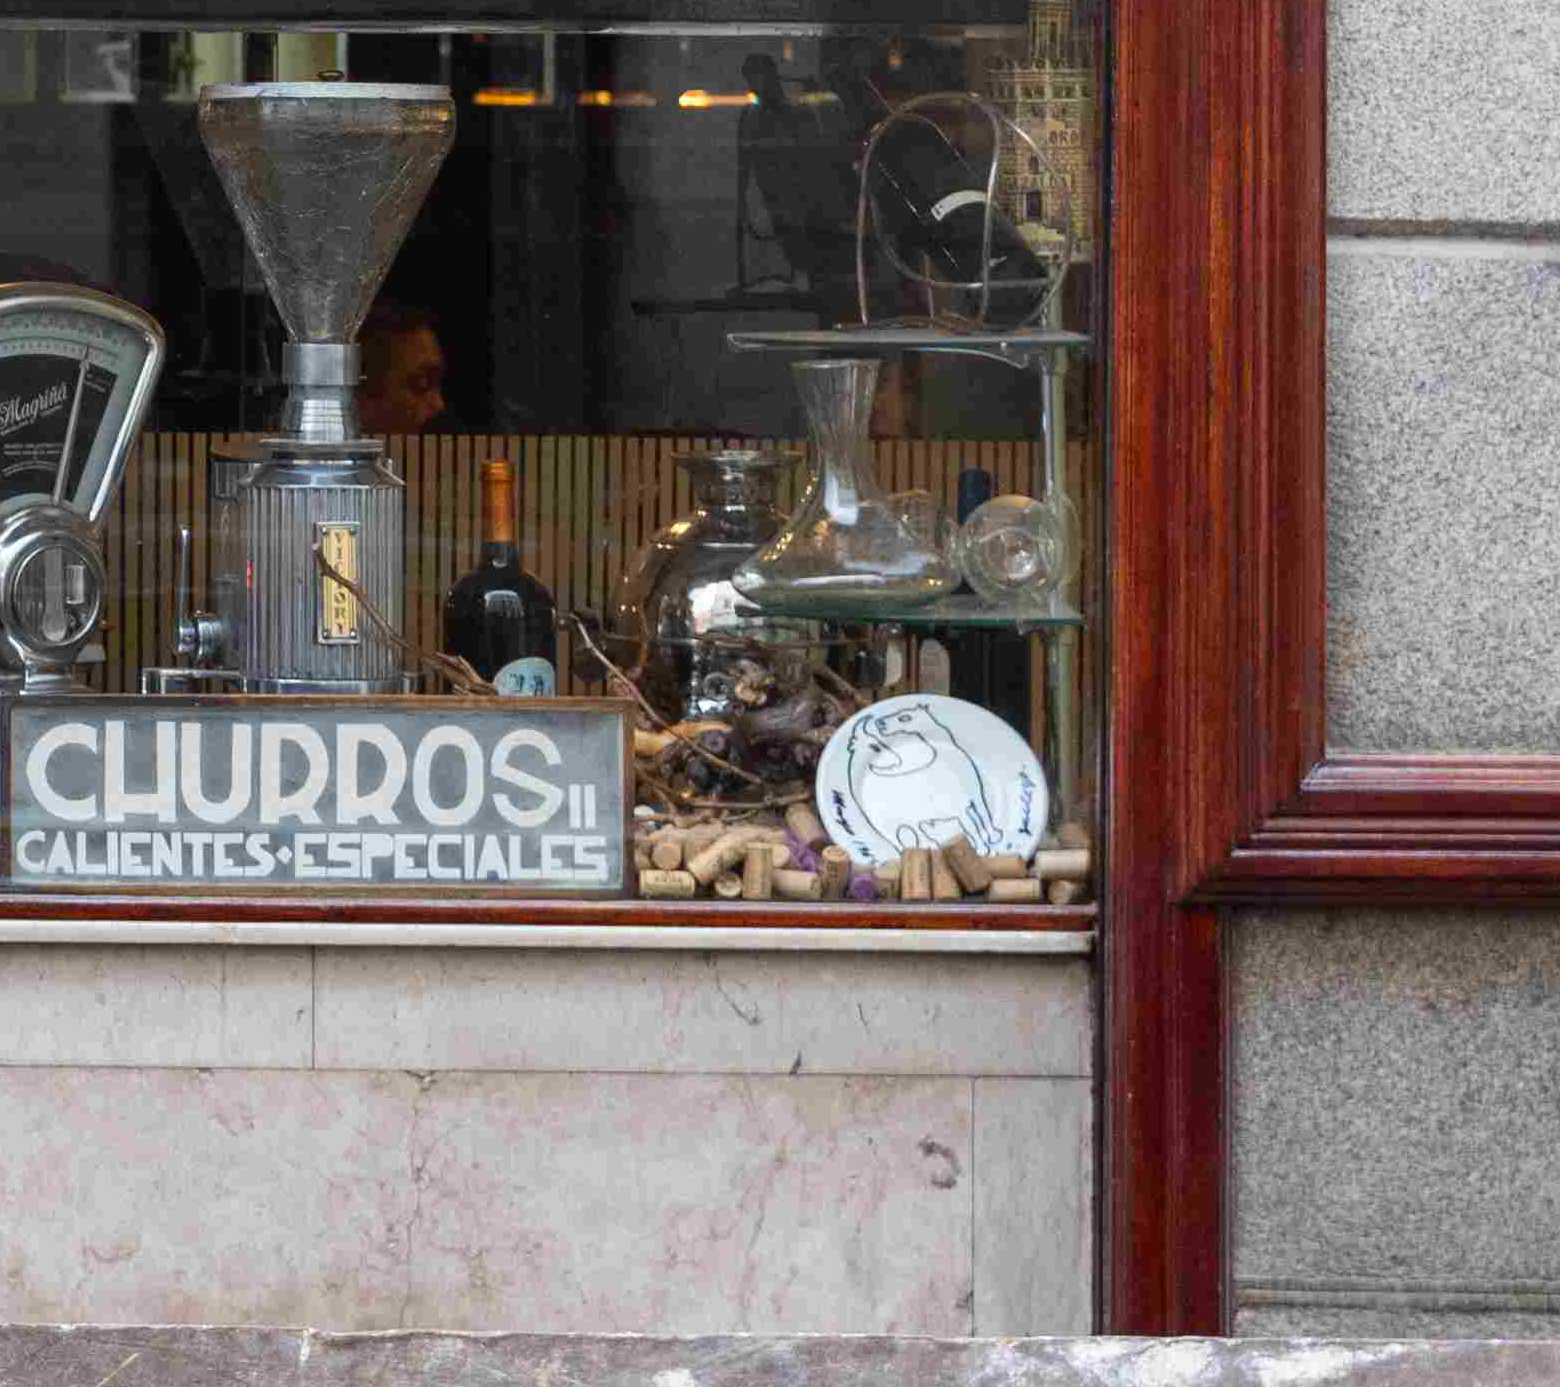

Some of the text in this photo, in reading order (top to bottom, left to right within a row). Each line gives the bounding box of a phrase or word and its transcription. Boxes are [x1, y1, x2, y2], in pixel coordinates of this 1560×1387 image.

[25, 720, 564, 828] CHURROS
[16, 829, 609, 883] CALIENTES ESPECIALES
